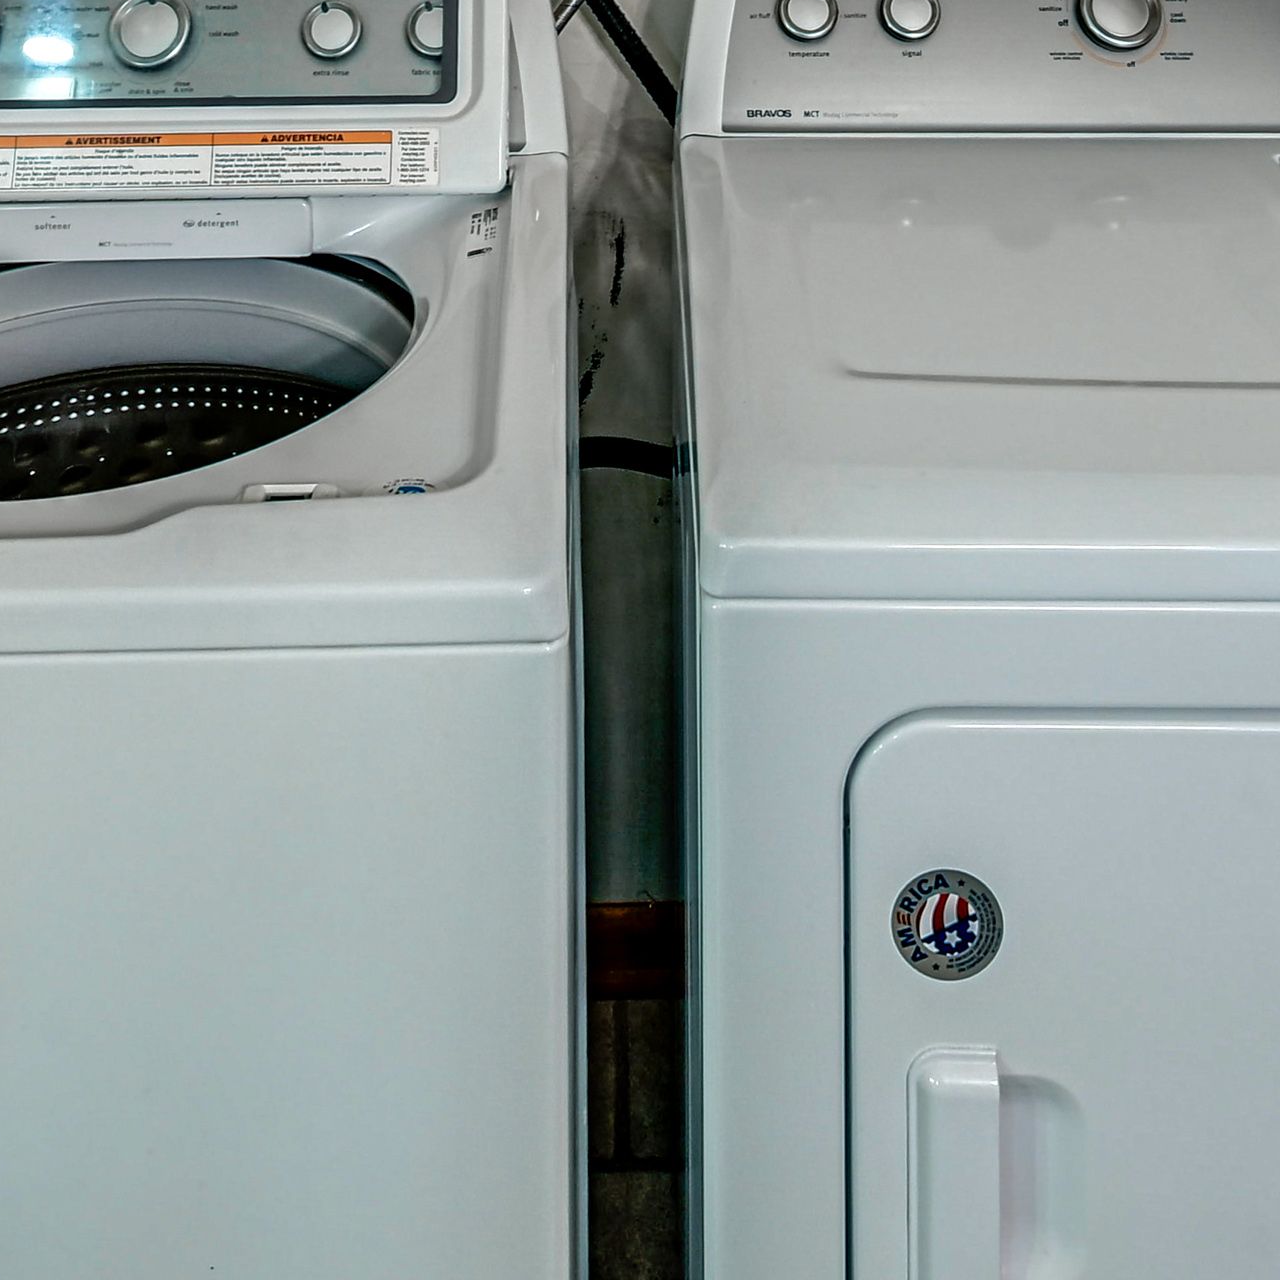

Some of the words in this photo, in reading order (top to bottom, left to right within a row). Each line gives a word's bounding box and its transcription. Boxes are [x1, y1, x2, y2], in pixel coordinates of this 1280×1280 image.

[1057, 19, 1069, 27] off
[902, 50, 923, 58] signal
[746, 109, 792, 118] BRAVOS
[803, 110, 820, 118] MCT
[75, 136, 163, 145] AVERTISSEMENT
[270, 133, 344, 142] ADVERTENCIA
[34, 222, 71, 230] softener
[196, 219, 239, 229] detergent
[896, 873, 951, 963] AMERICA
